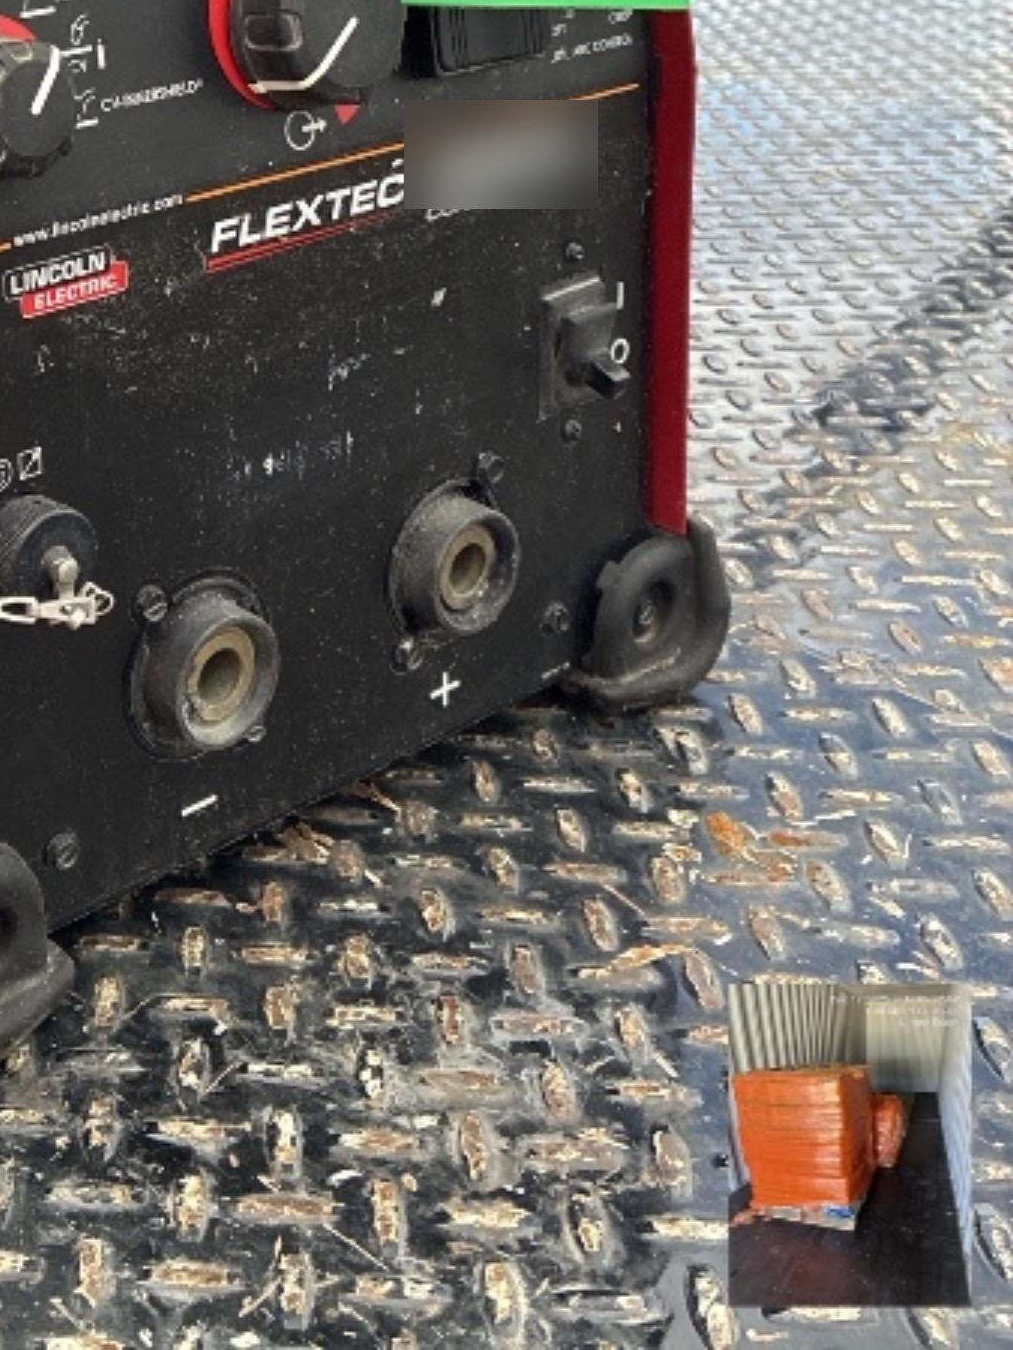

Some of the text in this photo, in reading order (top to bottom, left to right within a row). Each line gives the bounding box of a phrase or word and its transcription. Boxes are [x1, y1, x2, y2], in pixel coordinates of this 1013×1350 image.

[210, 172, 404, 254] FLEXTEC
[9, 251, 107, 296] LINCOLN
[33, 274, 117, 312] ELECTRIC
